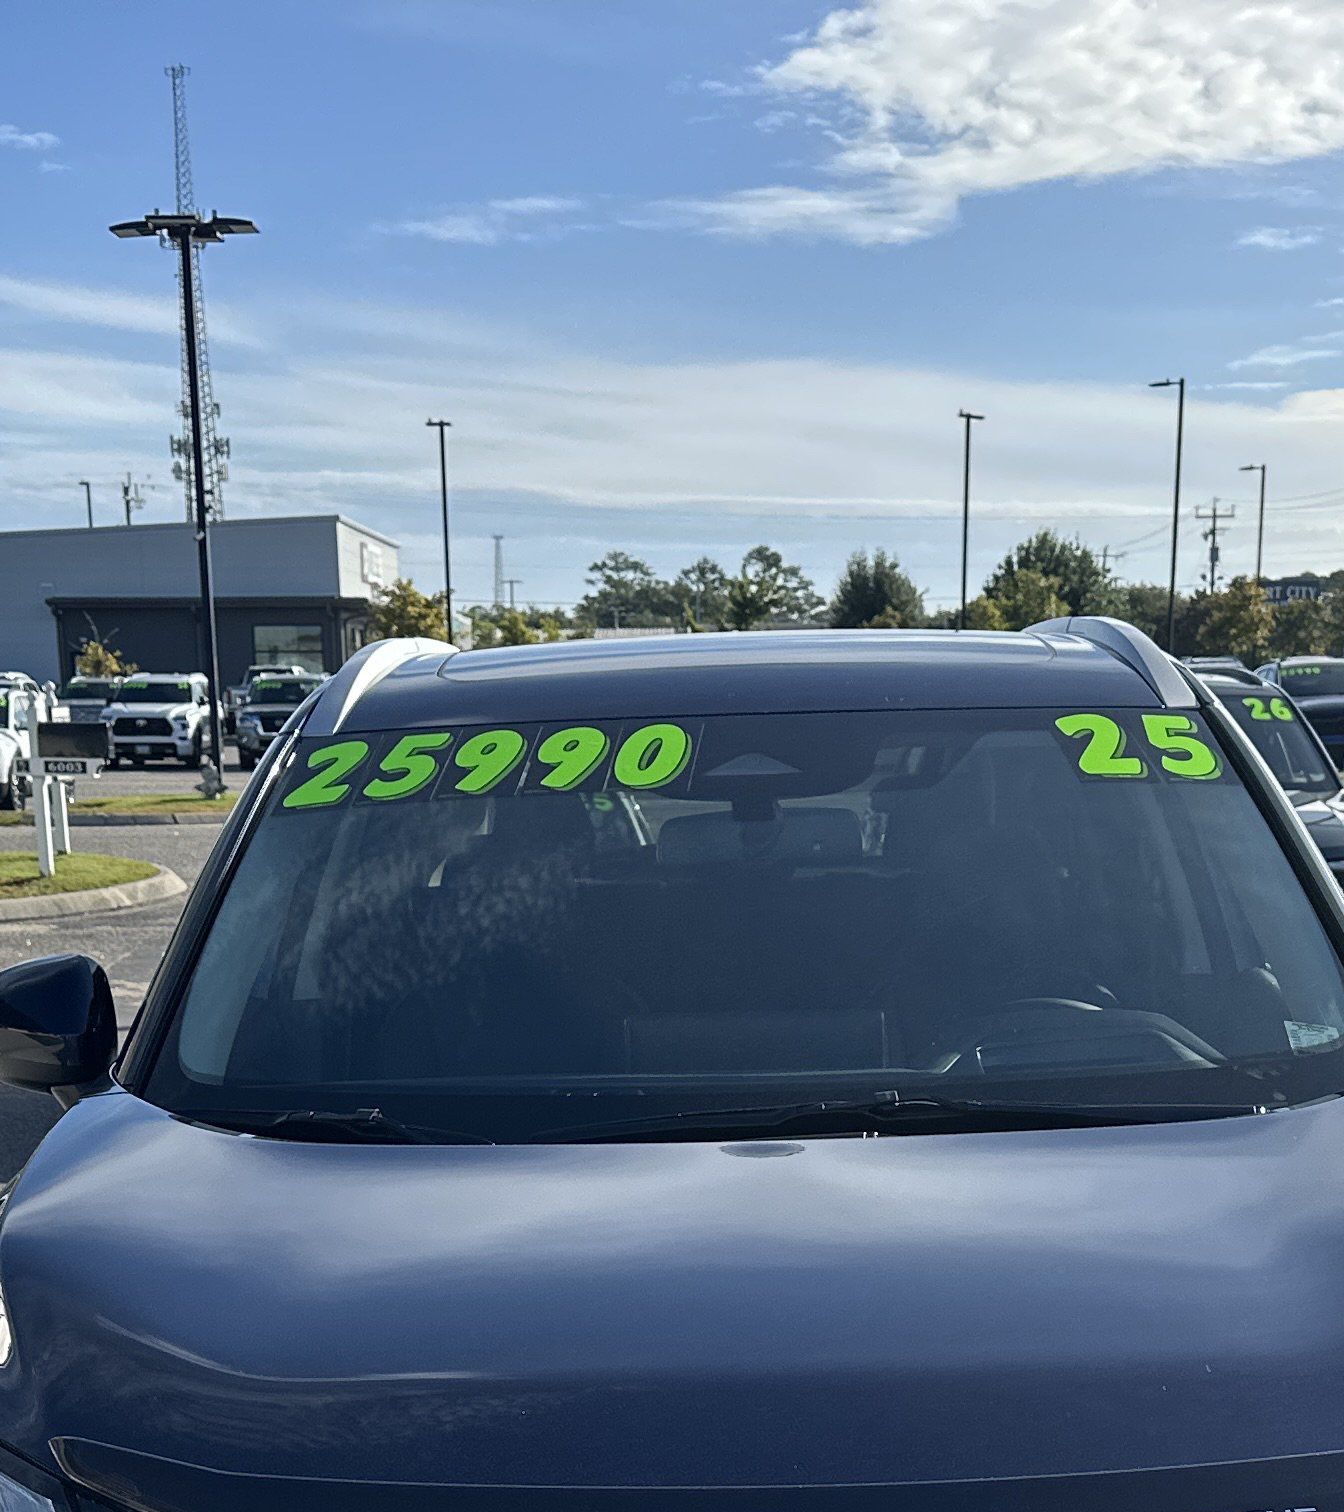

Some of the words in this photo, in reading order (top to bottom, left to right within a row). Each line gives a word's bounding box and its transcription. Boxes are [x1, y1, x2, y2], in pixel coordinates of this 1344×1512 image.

[1242, 697, 1294, 721] 26
[283, 724, 692, 809] 25990
[1055, 713, 1223, 780] 25
